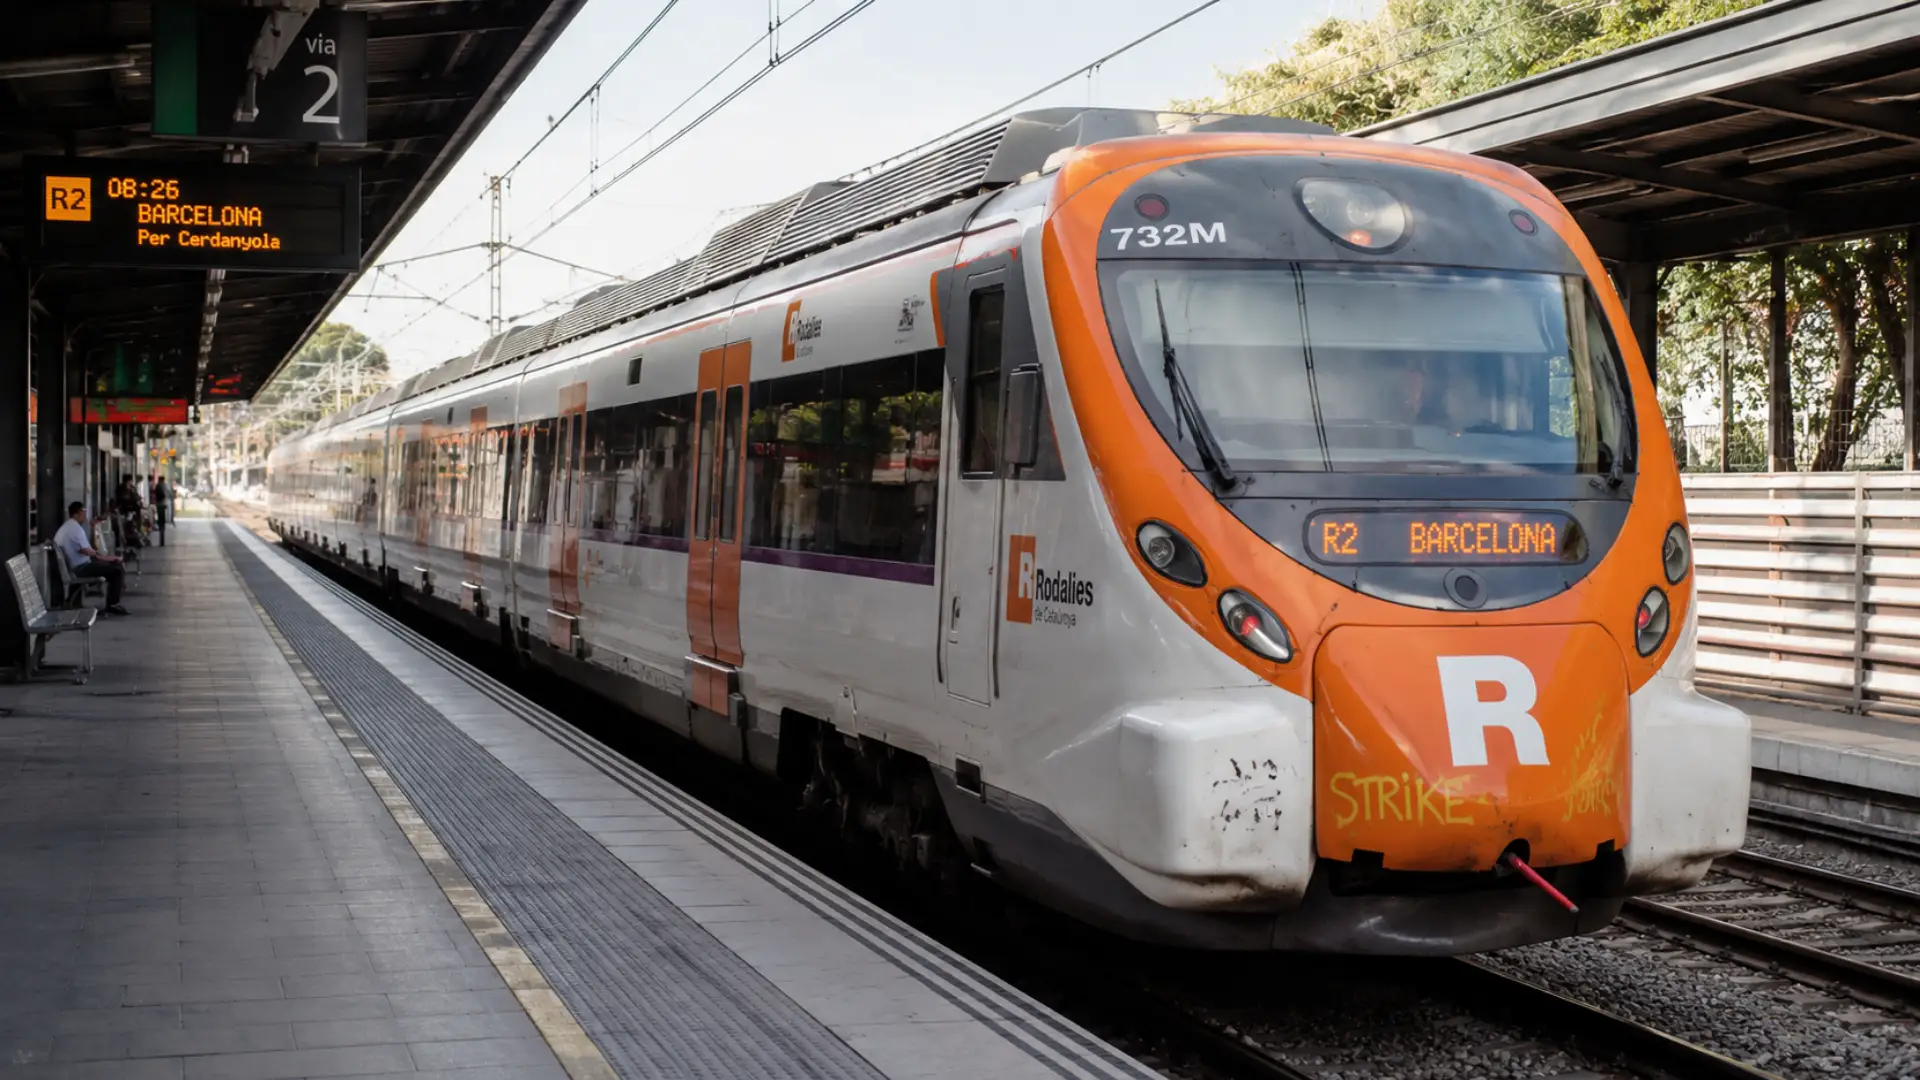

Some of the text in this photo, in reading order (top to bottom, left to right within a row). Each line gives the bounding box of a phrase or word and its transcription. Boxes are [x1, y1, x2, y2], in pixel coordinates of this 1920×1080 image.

[305, 33, 337, 56] via
[302, 64, 341, 125] 2
[50, 187, 87, 212] R2
[107, 177, 180, 200] 08:26
[137, 203, 262, 227] BARCELONA
[137, 228, 281, 251] Per Cerdanyola
[1110, 222, 1227, 251] 732M
[1322, 521, 1557, 555] R2 BARCELONA
[1018, 551, 1034, 600] R
[1035, 568, 1094, 607] Rodalies
[1436, 654, 1550, 767] R
